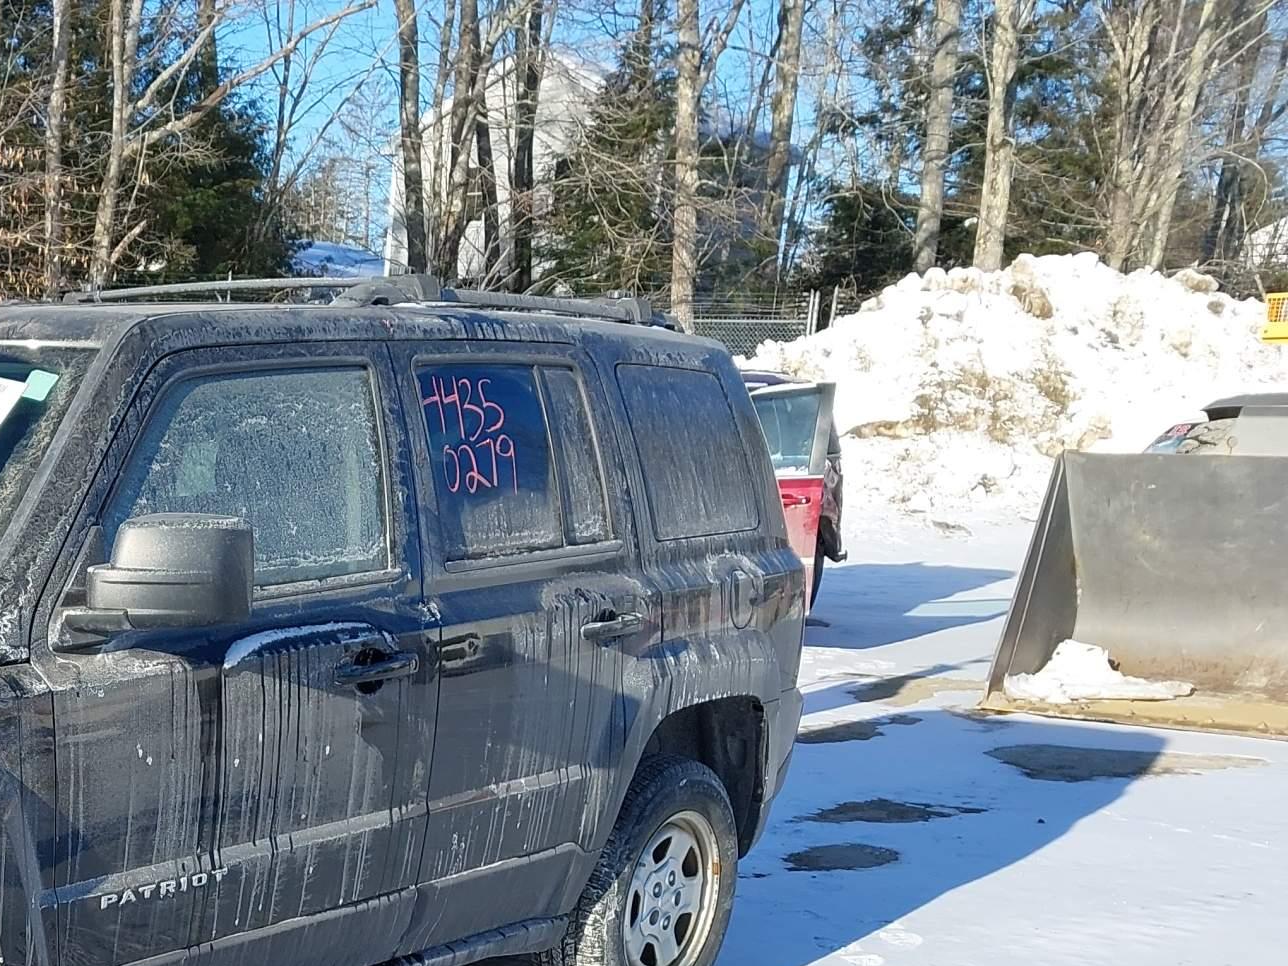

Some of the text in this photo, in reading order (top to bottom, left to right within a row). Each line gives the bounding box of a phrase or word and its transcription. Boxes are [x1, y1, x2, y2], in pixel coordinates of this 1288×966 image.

[423, 374, 505, 441] 4435
[442, 434, 519, 496] 0279
[99, 867, 228, 910] PATRIOT
